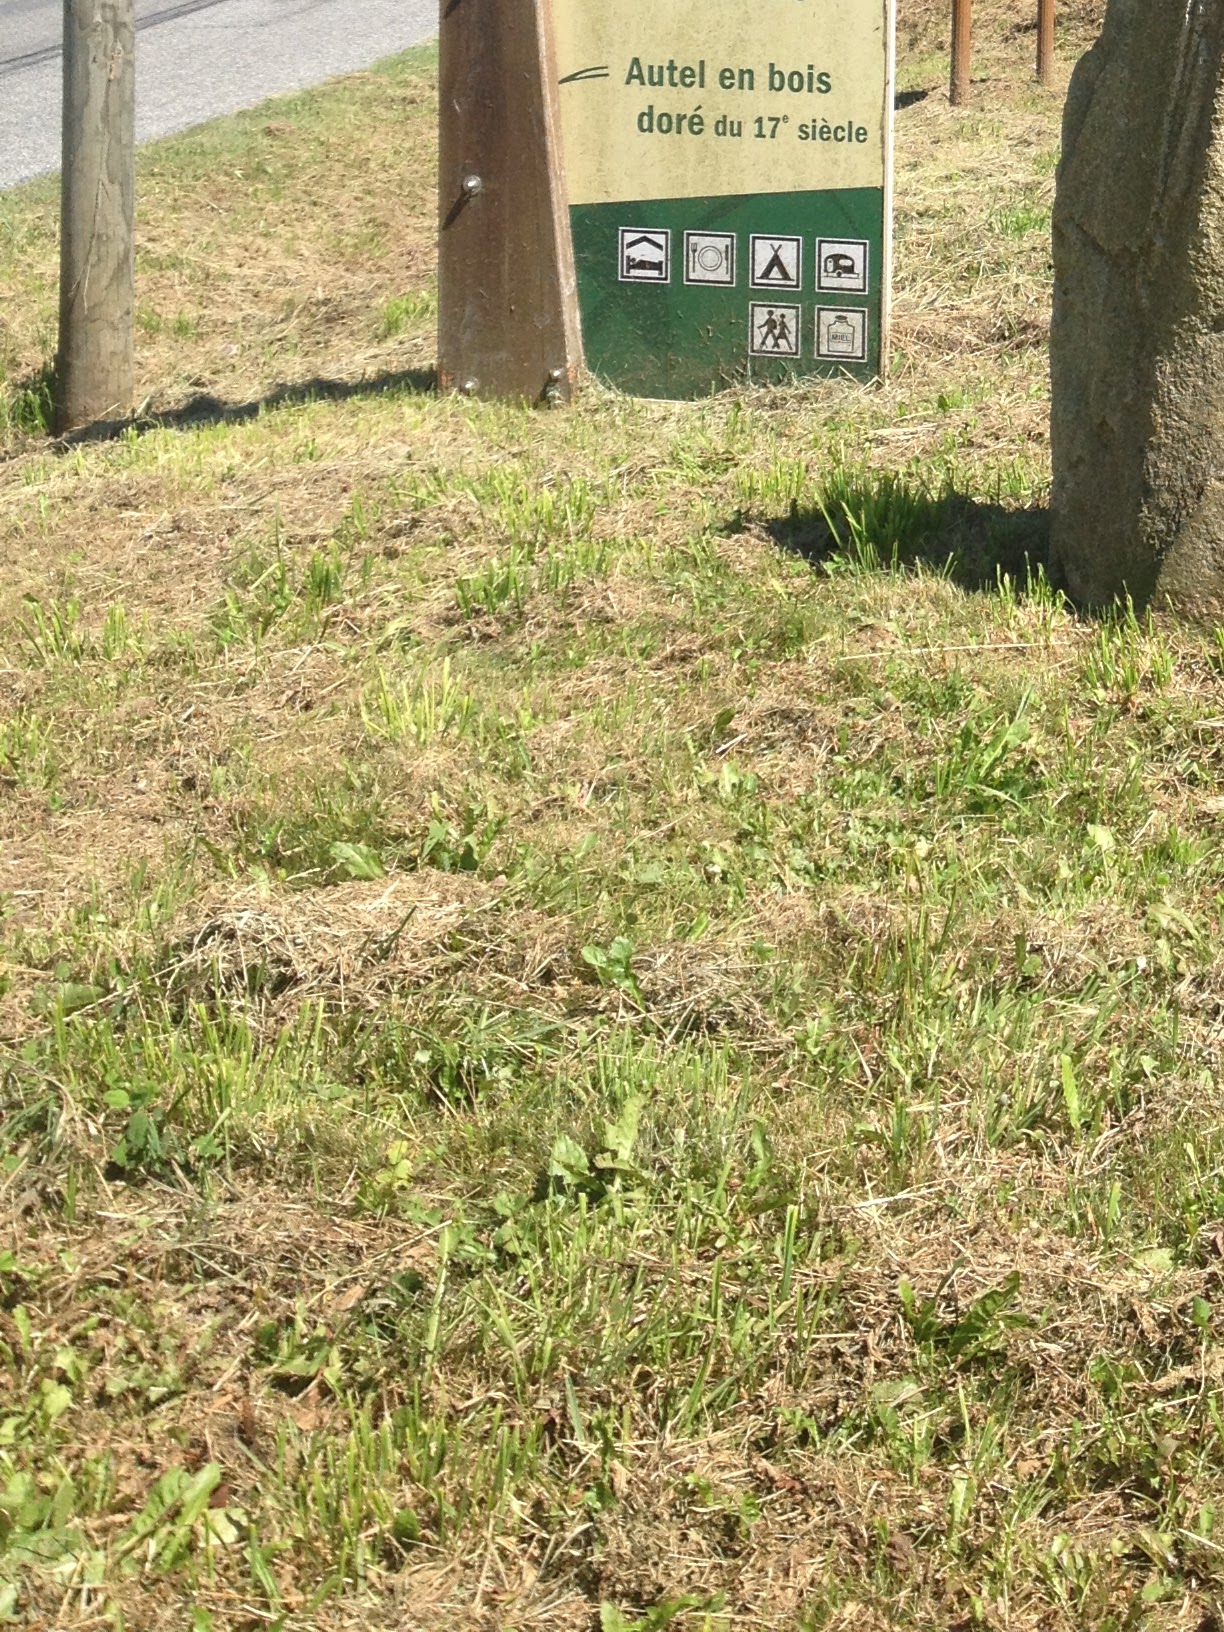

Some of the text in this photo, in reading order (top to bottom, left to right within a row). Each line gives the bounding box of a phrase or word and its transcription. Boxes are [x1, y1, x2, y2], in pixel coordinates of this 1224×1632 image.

[624, 56, 833, 95] Autel en bois
[636, 104, 869, 144] doré du 17e siècle
